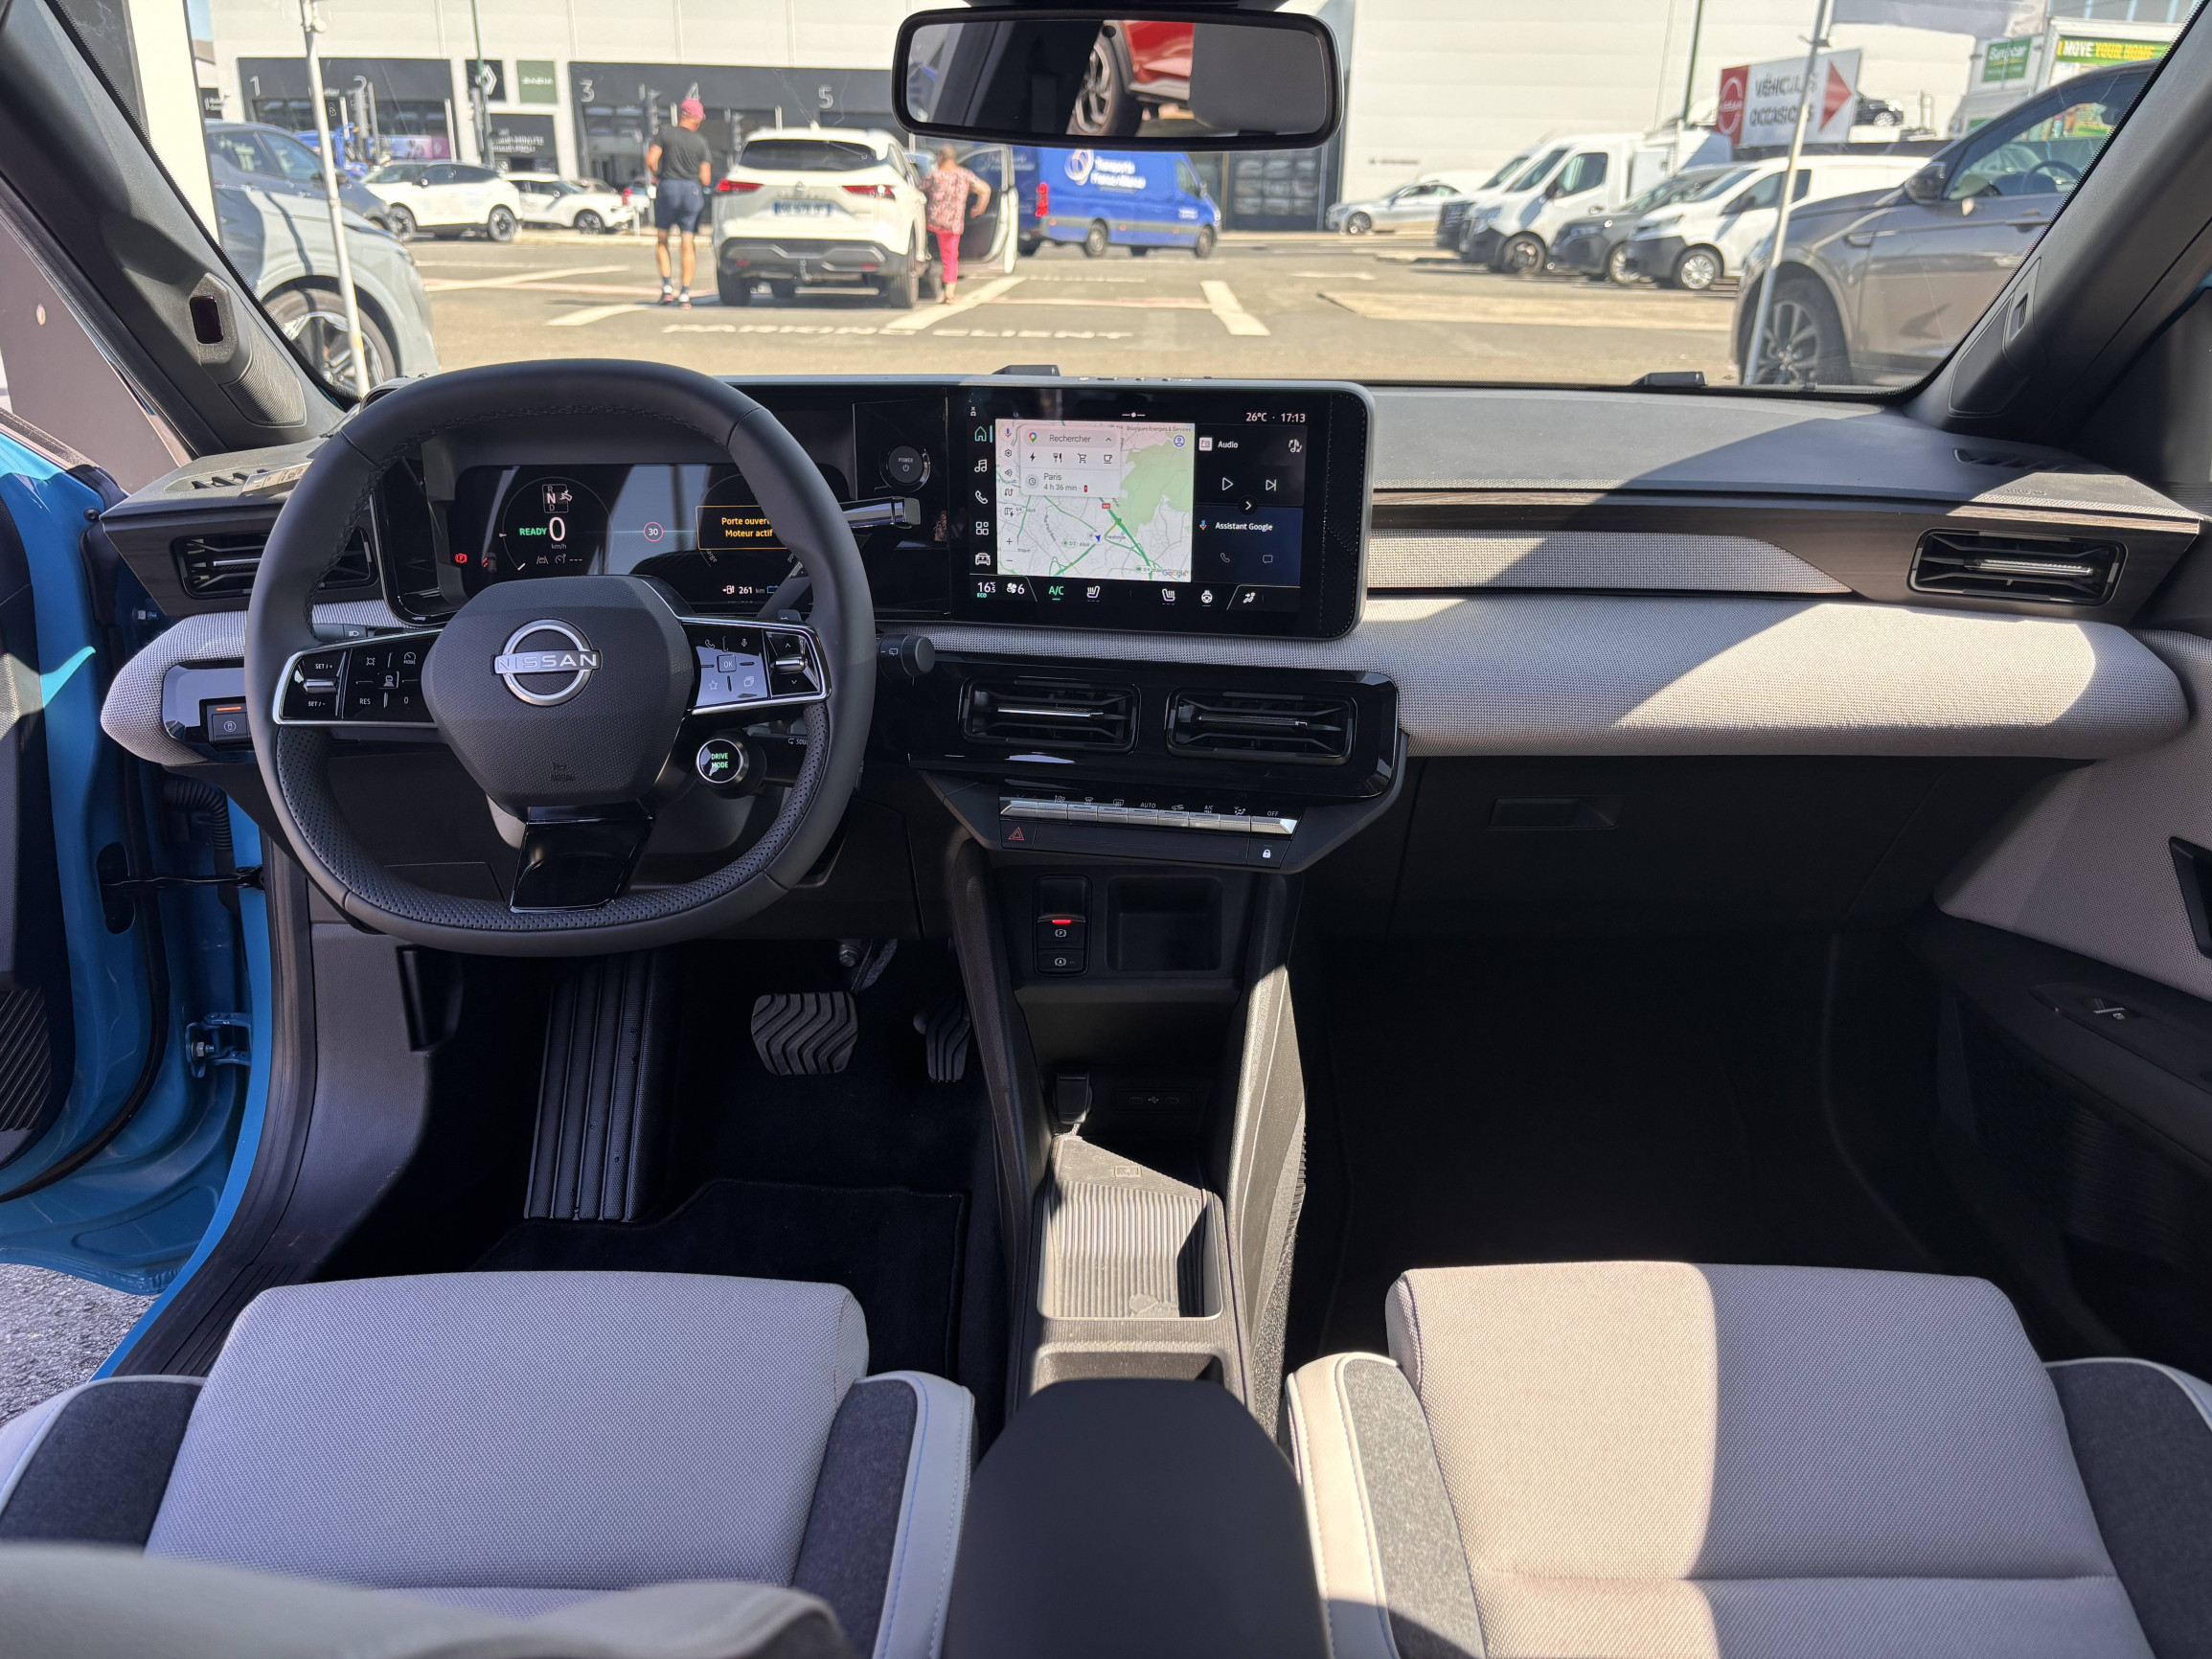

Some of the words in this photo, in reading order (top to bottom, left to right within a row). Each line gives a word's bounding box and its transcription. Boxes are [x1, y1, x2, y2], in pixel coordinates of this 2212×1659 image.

[2063, 40, 2094, 57] MOVE
[2095, 42, 2123, 59] YOUR
[2124, 43, 2155, 59] HOME
[249, 76, 261, 97] 1
[580, 80, 595, 102] 3
[686, 81, 699, 101] 4
[1755, 73, 1817, 98] VÉHICULS
[818, 86, 834, 109] 5
[1748, 102, 1814, 126] OCCASIOS
[1281, 413, 1306, 422] 17:13
[1049, 434, 1092, 443] Rechercher
[1043, 472, 1062, 481] Paris
[546, 492, 557, 505] N
[721, 517, 743, 526] Porte
[1215, 521, 1247, 531] Assistant
[1248, 522, 1273, 533] Google
[518, 527, 548, 536] READY
[548, 516, 566, 542] 0
[648, 528, 659, 536] 30
[725, 529, 754, 537] Moteur
[755, 529, 773, 537] actif
[1161, 568, 1187, 579] Google
[739, 585, 753, 595] 261
[1017, 584, 1025, 595] 6
[1048, 586, 1064, 596] A/C
[497, 653, 598, 671] NISSAN
[723, 660, 733, 669] OK
[1140, 801, 1156, 809] AUTO
